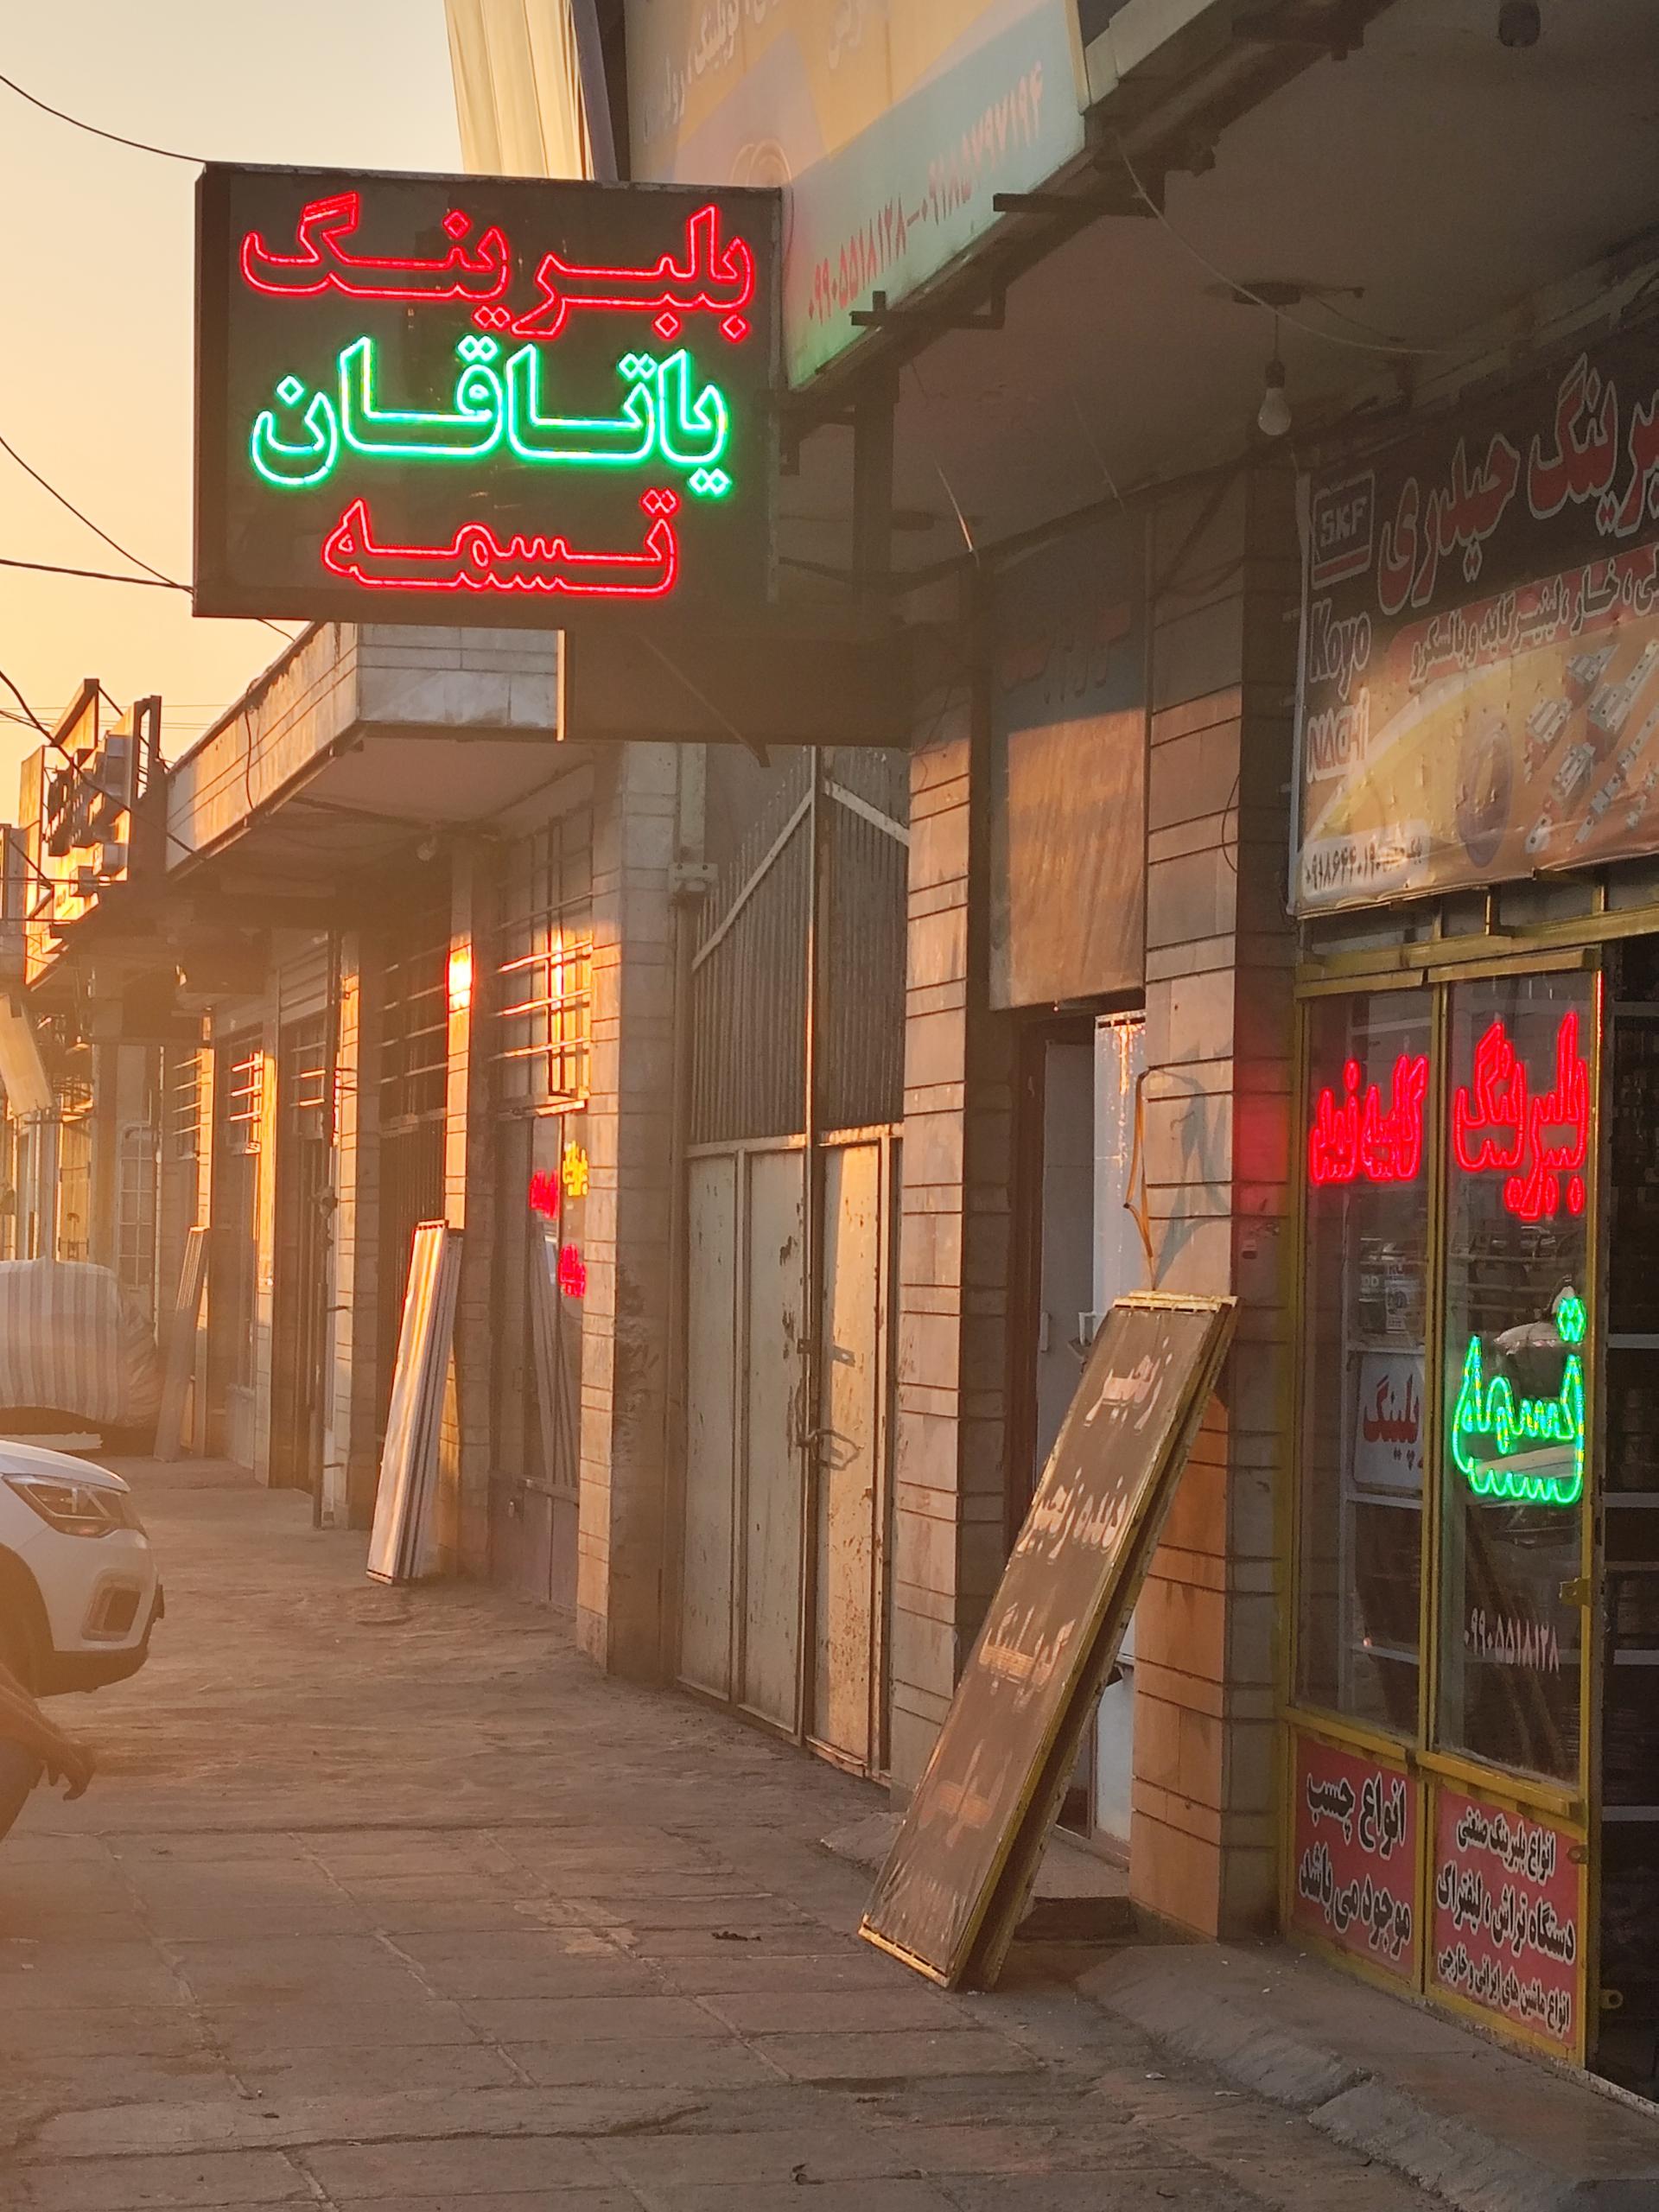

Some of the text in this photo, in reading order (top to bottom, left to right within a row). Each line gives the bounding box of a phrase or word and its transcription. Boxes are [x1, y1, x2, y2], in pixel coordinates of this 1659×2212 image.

[241, 191, 755, 342] بلبرینگ
[251, 335, 732, 498] یاتاقان
[321, 488, 680, 598] تسمه
[1319, 496, 1369, 548] SKF
[1309, 597, 1371, 701] Koyo
[1306, 686, 1370, 784] NACHI
[1452, 1011, 1589, 1221] بلبرینگ
[1452, 1294, 1586, 1504] تسمه
[1306, 1771, 1407, 1860] انواع چسب
[1457, 1805, 1556, 1886] انواع بلبرینگ صنعتی
[1300, 1841, 1412, 1961] موجود می باشد
[1436, 1859, 1483, 1935] لیفتراک
[1529, 1896, 1576, 1966] دستگاه
[1438, 1942, 1468, 1987] خارجی
[1475, 1953, 1501, 2003] ایرانی
[1500, 1966, 1520, 2012] های
[1520, 1977, 1546, 2021] ماشین
[1546, 1987, 1572, 2040] انواع
